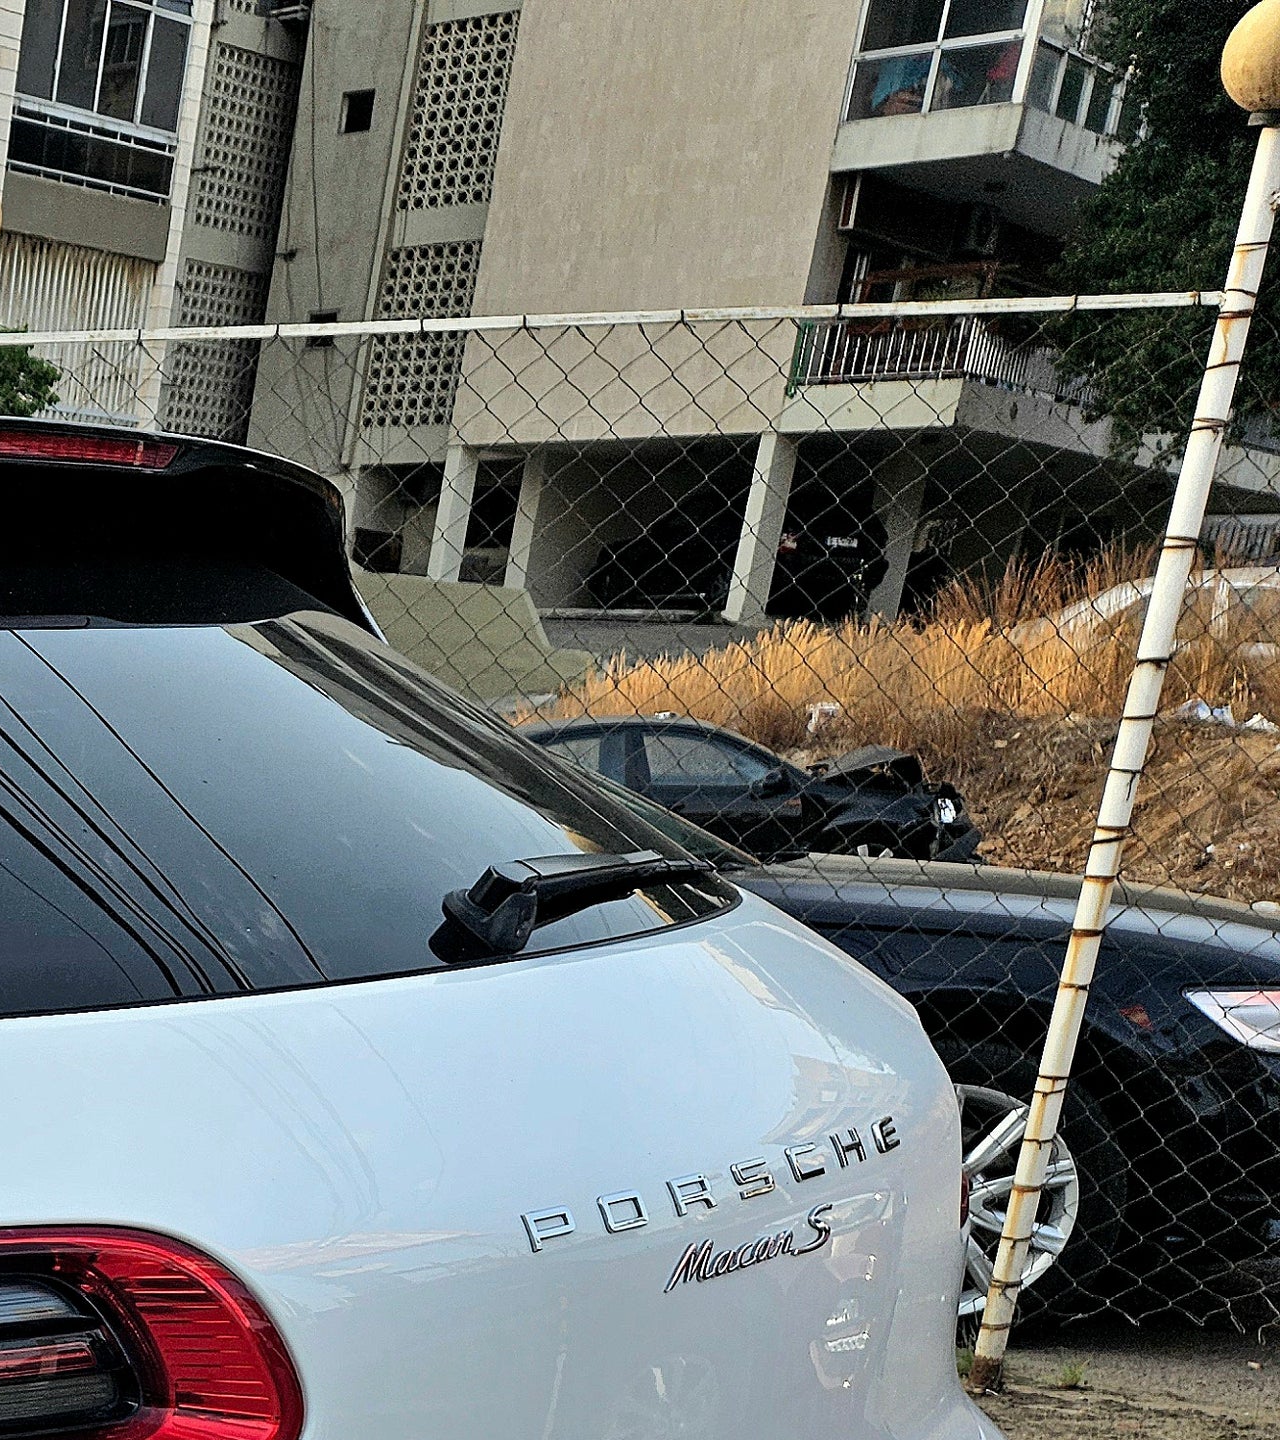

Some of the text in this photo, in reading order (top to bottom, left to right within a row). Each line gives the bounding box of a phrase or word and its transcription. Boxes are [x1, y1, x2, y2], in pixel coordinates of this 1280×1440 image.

[520, 1115, 901, 1253] PORSCHE
[663, 1203, 834, 1294] Macan S
